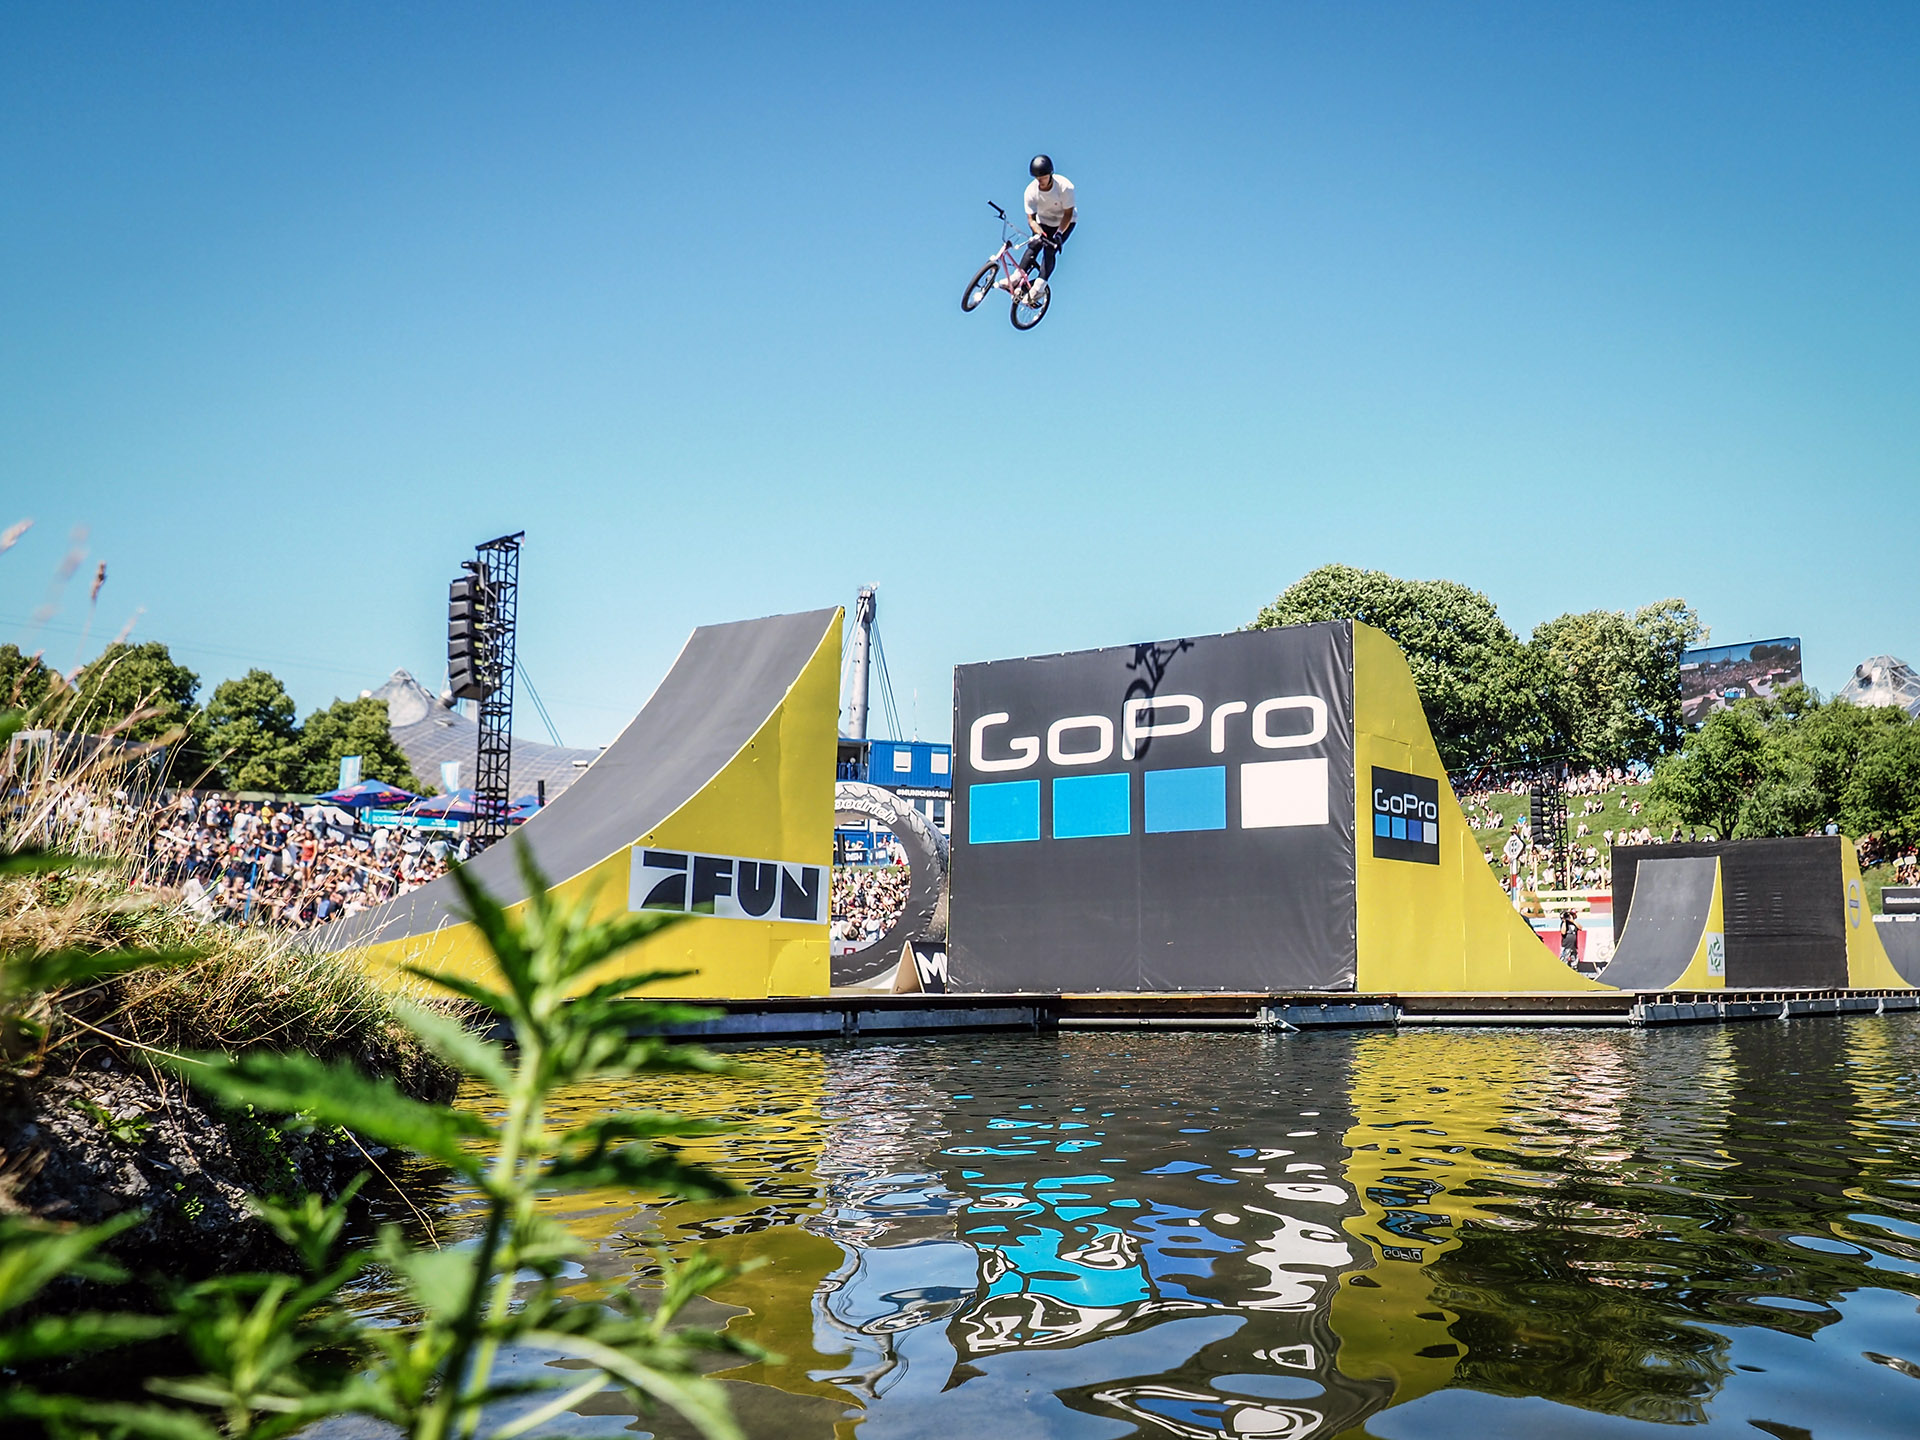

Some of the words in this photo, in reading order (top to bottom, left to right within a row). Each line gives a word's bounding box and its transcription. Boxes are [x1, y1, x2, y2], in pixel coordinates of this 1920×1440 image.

[969, 694, 1329, 773] GoPro
[1374, 788, 1437, 820] GoPro
[640, 850, 820, 922] 7FUN
[915, 951, 948, 984] M
